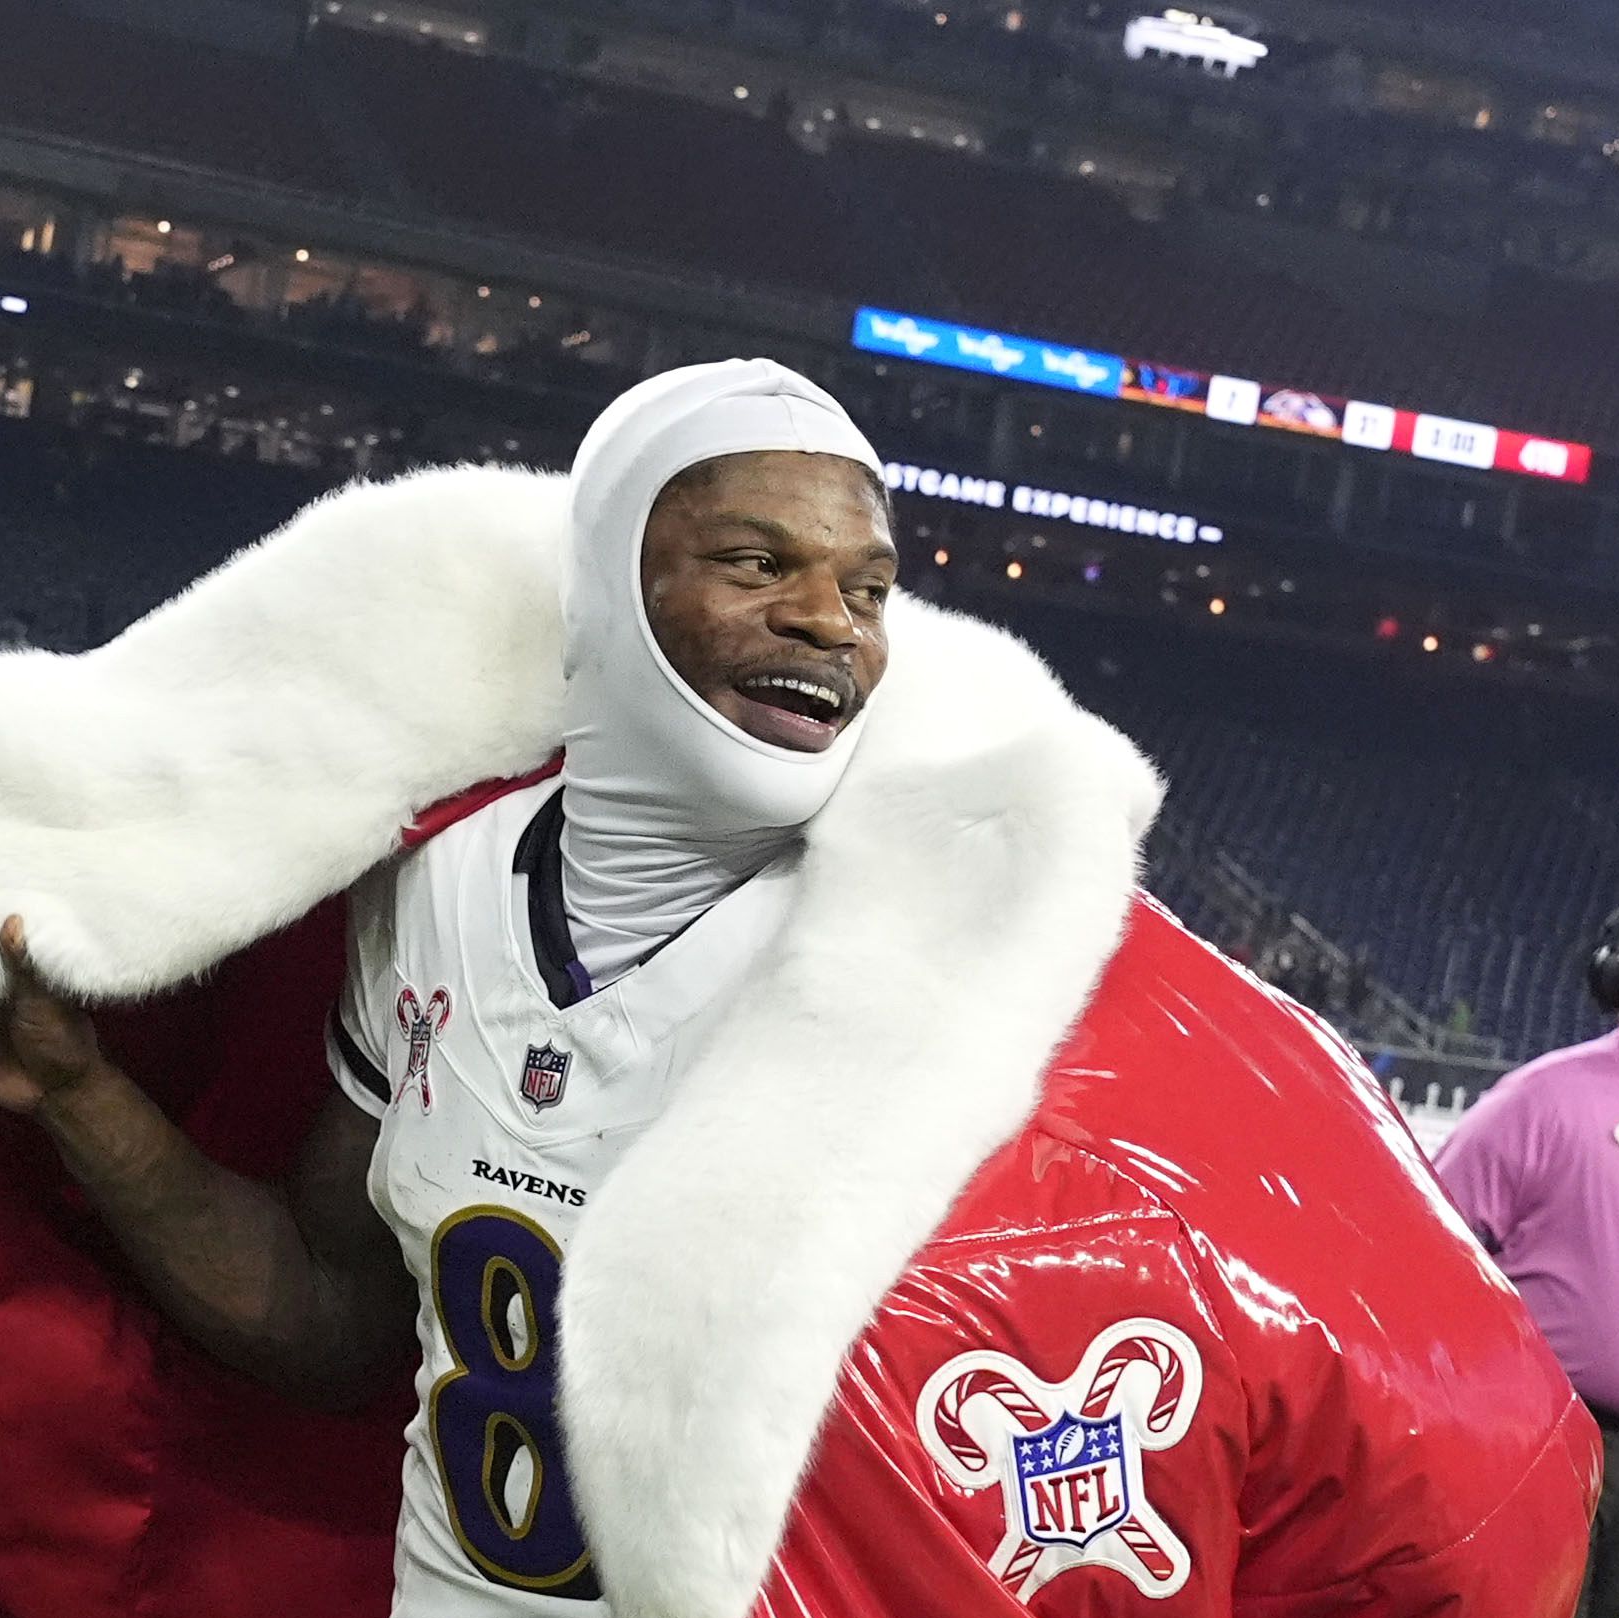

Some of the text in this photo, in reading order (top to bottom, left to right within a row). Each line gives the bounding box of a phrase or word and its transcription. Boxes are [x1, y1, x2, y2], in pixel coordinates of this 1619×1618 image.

[884, 461, 1007, 509] STGAME
[522, 1069, 560, 1102] NFL
[471, 1158, 588, 1208] RAVENS
[430, 1203, 596, 1590] 8
[1028, 1464, 1122, 1535] NFL
